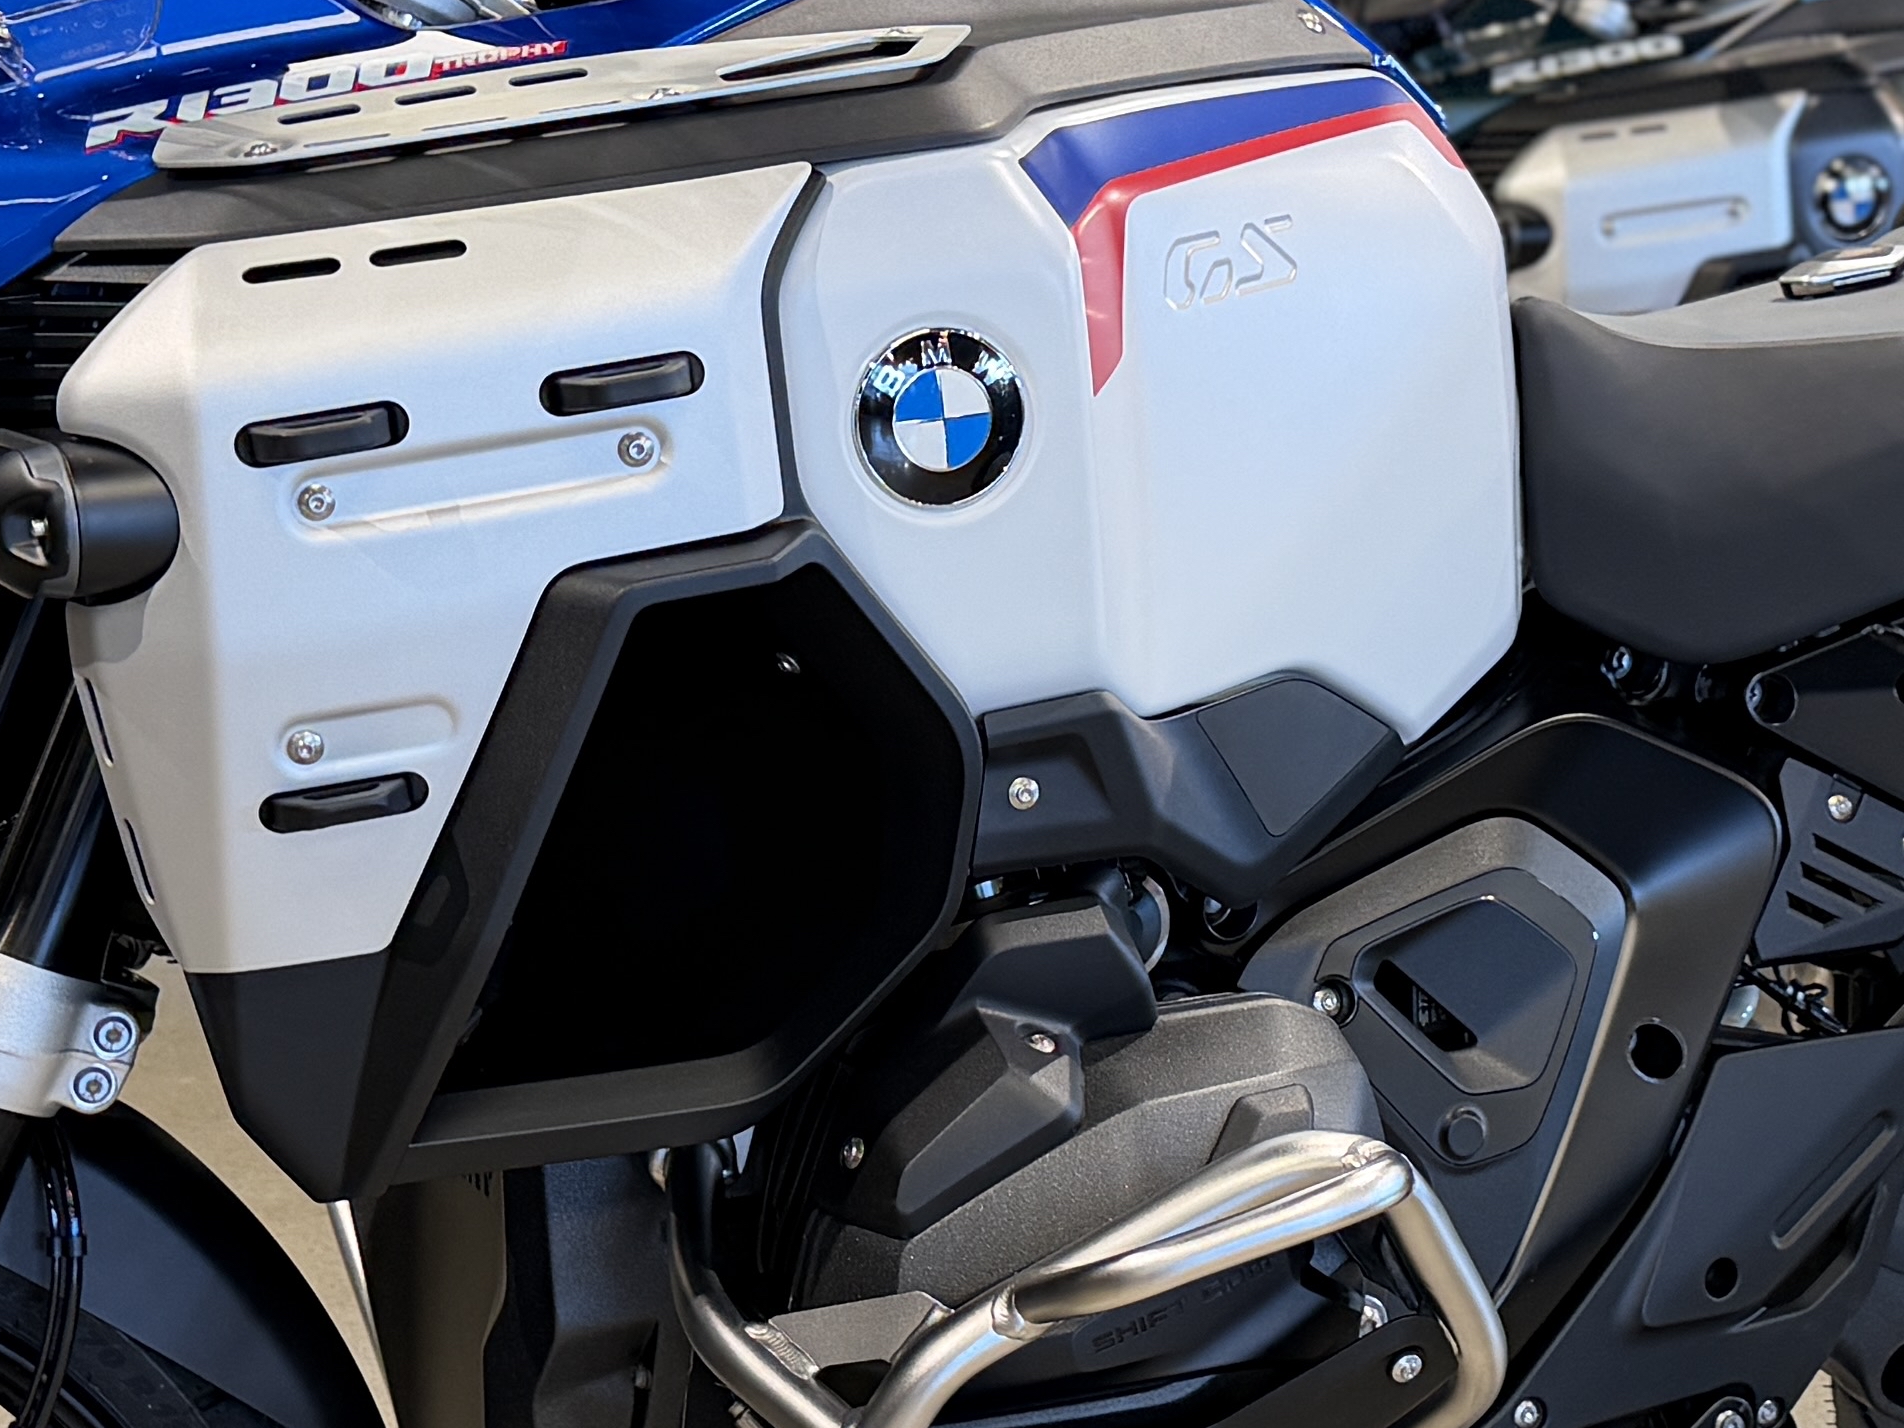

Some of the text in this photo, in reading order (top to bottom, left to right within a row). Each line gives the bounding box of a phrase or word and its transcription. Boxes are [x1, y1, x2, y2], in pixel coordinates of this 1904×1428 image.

[84, 40, 568, 154] R1300 TROPHY
[1163, 213, 1298, 311] GS
[1090, 1296, 1188, 1353] SHIFT
